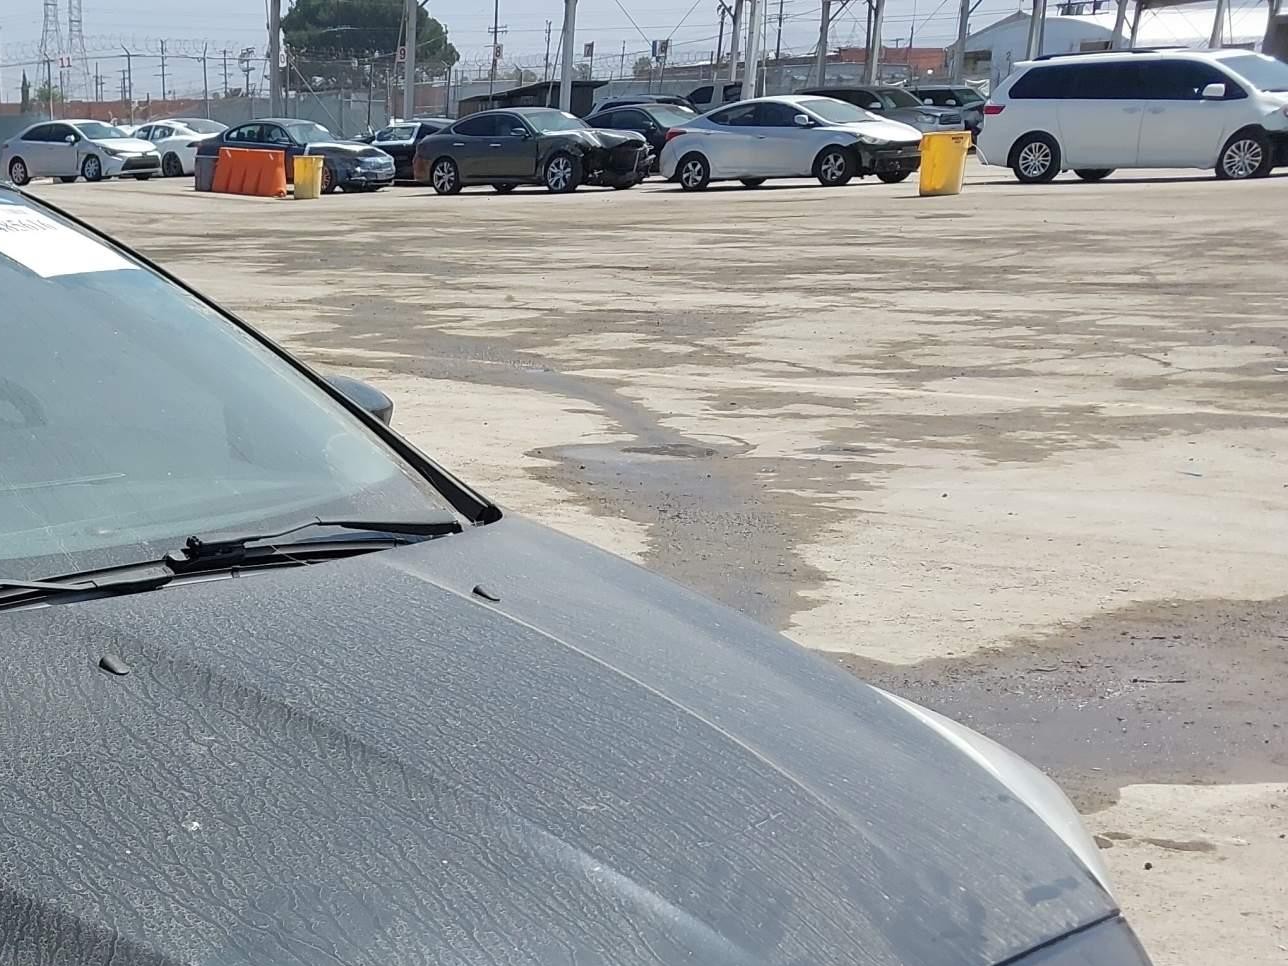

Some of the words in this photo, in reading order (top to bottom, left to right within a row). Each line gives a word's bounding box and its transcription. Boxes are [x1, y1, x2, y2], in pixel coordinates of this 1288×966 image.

[399, 47, 407, 60] 9
[495, 45, 501, 58] 8
[58, 56, 73, 69] 11
